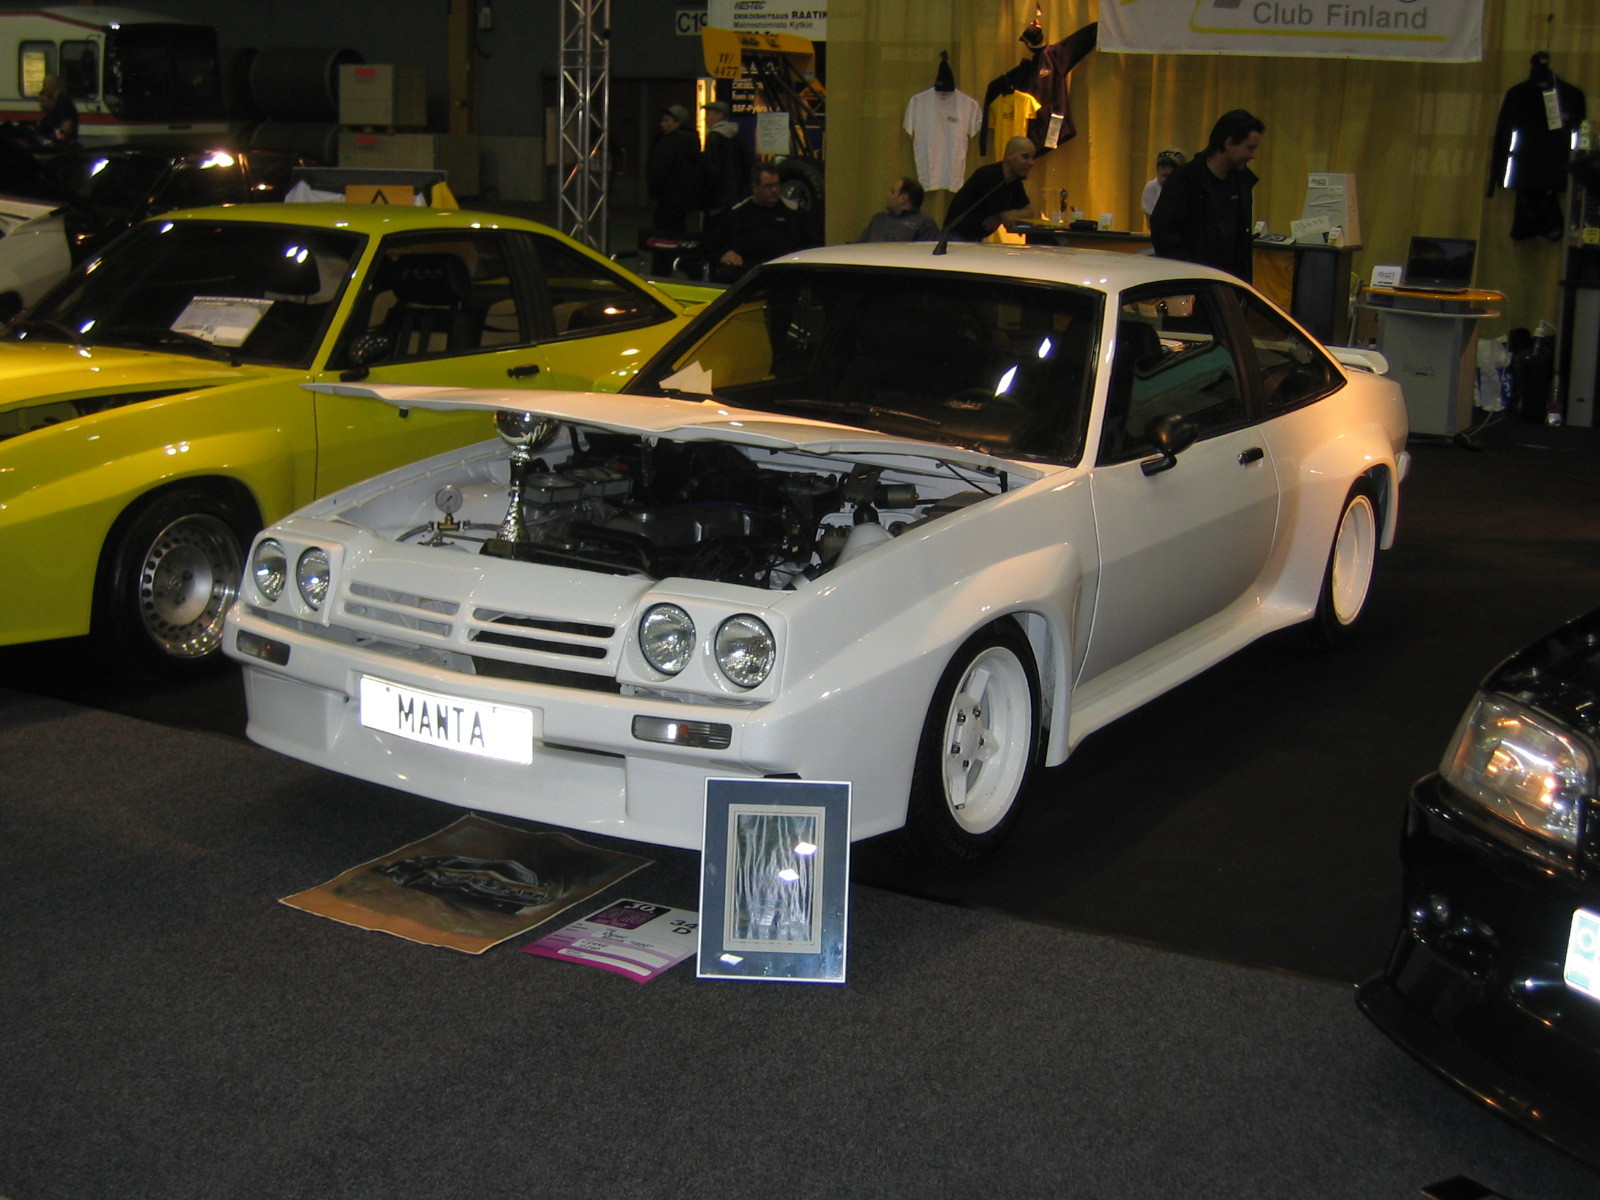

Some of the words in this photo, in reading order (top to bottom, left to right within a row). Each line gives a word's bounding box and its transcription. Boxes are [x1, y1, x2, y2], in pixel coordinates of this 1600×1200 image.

[1253, 3, 1313, 25] Club
[1326, 4, 1428, 29] Finland
[398, 693, 485, 748] MANTA
